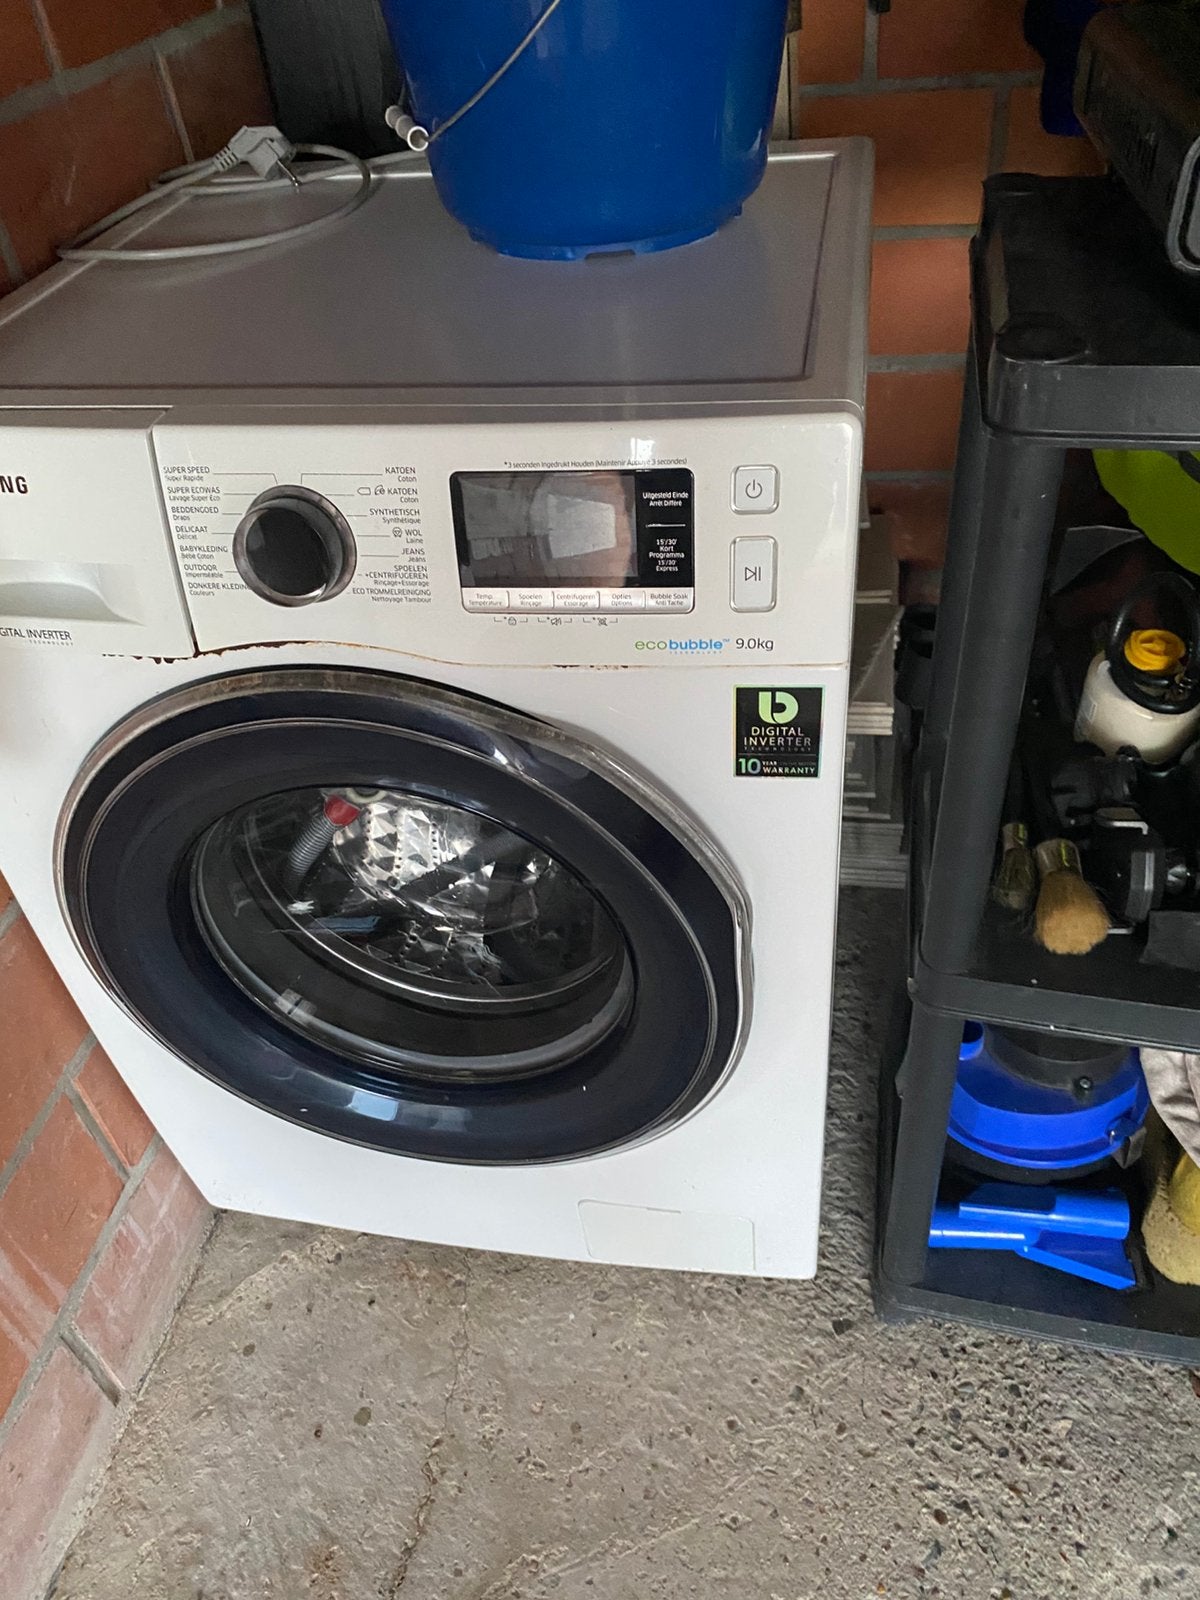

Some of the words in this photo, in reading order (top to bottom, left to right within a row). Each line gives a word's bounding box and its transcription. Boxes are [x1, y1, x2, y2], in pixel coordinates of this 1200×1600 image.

[541, 460, 570, 469] Ingedrukt
[163, 466, 186, 474] SUPER
[187, 466, 210, 474] SPEED
[167, 486, 190, 494] SUPER
[191, 486, 221, 494] ECOWAS
[387, 487, 418, 495] KATOEN
[643, 492, 671, 500] Uitgesteld
[171, 506, 219, 514] BEDDENGOED
[175, 525, 208, 533] DELICAAT
[405, 529, 423, 537] WOL
[180, 545, 228, 553] BABYKLEDING
[188, 582, 220, 590] DONKERE
[221, 582, 249, 590] KLEDIN
[26, 629, 72, 641] INVERTER
[736, 638, 774, 652] 9.0kg
[751, 726, 804, 736] DIGITAL
[744, 737, 811, 746] INVERTER
[738, 758, 761, 774] 10
[763, 766, 815, 774] WARRANTY
